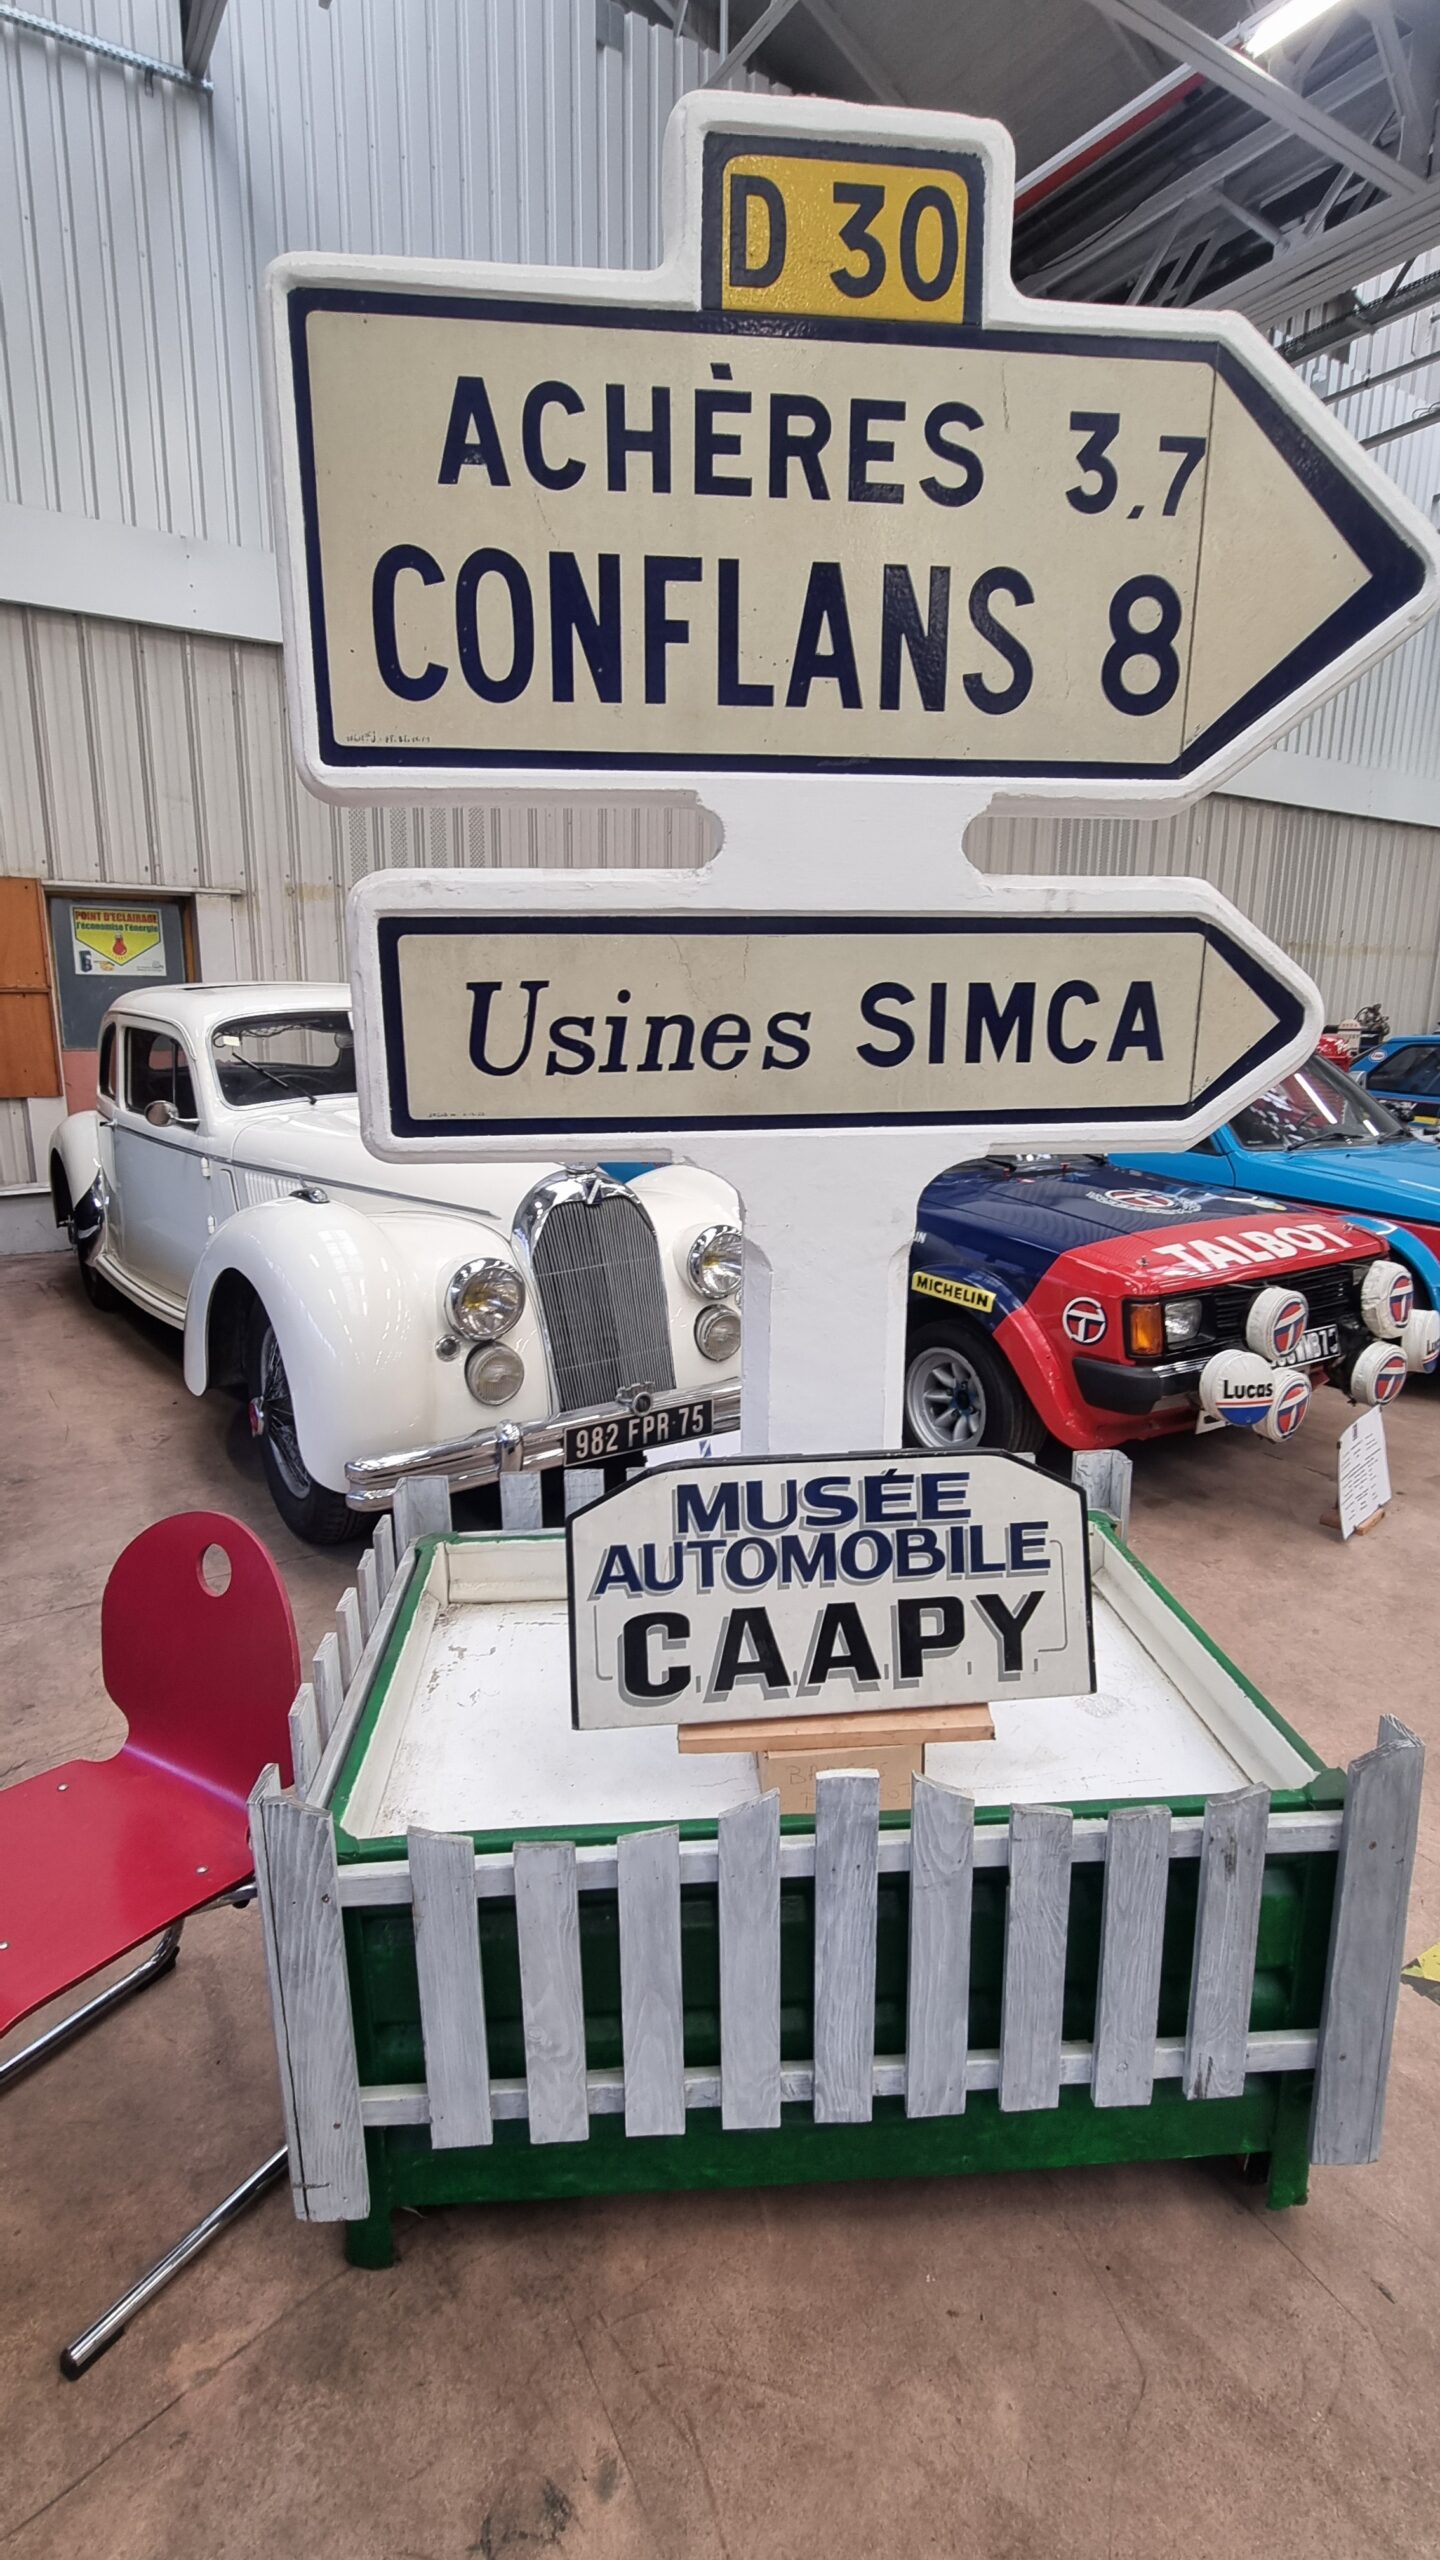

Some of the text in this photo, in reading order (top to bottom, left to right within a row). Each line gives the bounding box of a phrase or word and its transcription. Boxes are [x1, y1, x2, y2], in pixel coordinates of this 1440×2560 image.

[730, 173, 959, 302] D 30
[437, 362, 1207, 519] ACHÈRES 3,7
[371, 543, 1182, 716] CONFLANS 8
[75, 911, 101, 921] POINT
[465, 980, 1165, 1077] Usines SIMCA
[1152, 1224, 1353, 1273] TALBOT
[917, 1276, 990, 1308] MICHELIN
[1223, 1380, 1273, 1399] Lucas
[576, 1404, 704, 1459] 982 FPR 75
[676, 1468, 972, 1534] MUSÉE
[594, 1520, 1052, 1595] AUTOMOBILE
